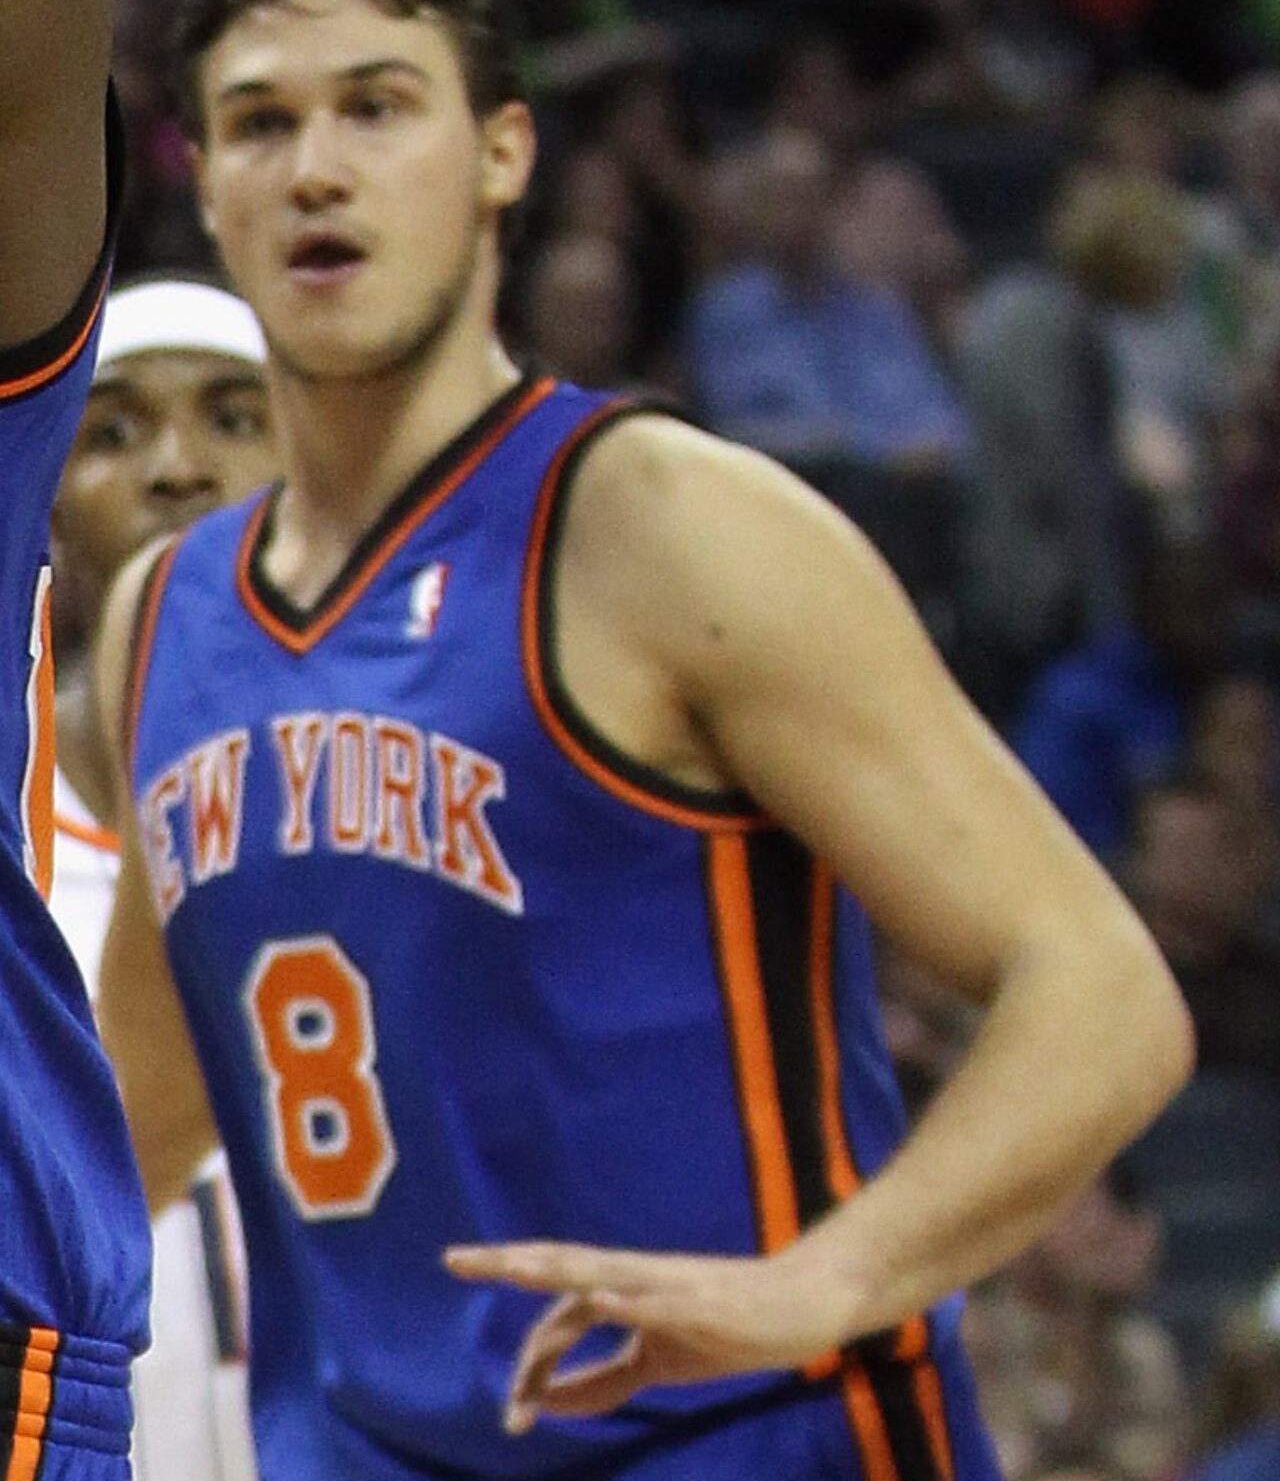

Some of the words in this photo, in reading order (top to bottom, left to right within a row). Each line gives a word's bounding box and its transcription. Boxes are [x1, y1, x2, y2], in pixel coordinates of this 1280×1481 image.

[140, 727, 251, 926] EW
[270, 711, 524, 916] YORK
[244, 934, 399, 1221] 8
